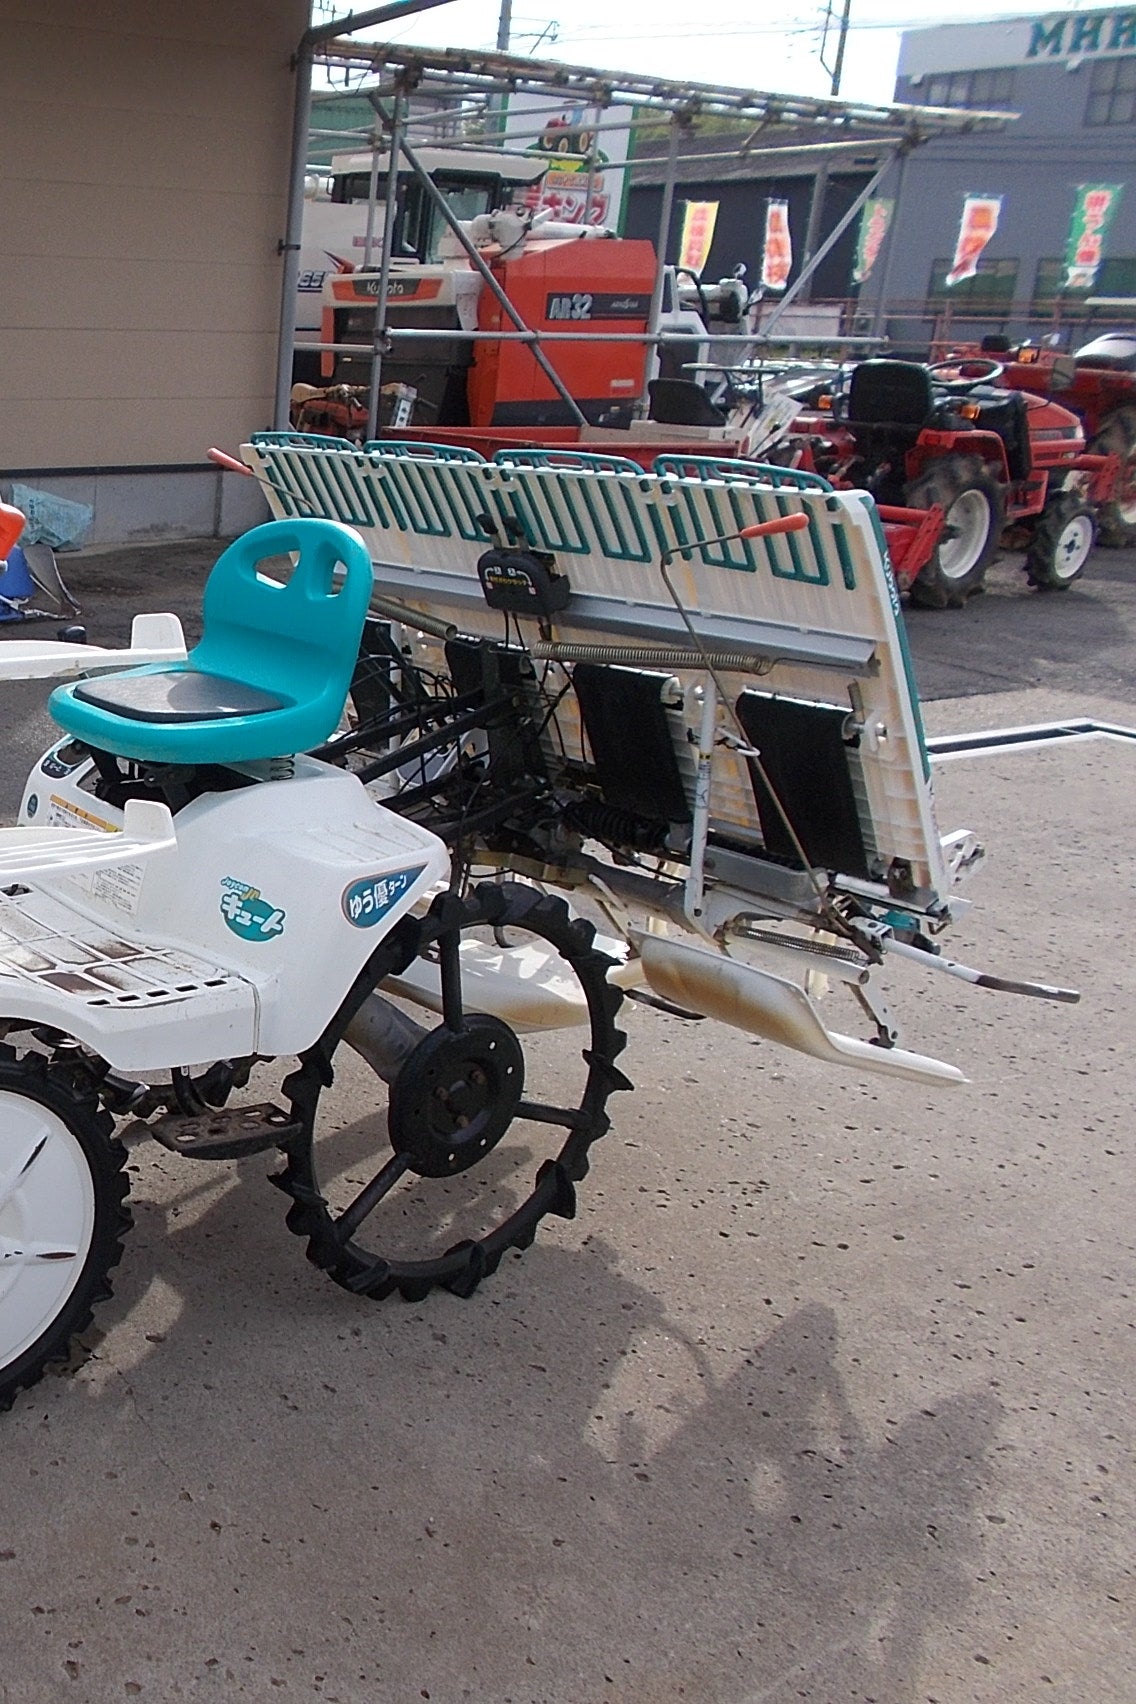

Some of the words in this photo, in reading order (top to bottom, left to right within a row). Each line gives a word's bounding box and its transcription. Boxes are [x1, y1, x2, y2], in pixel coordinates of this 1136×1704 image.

[366, 281, 404, 296] Kuota
[548, 293, 594, 320] AR32
[221, 893, 284, 933] キュート
